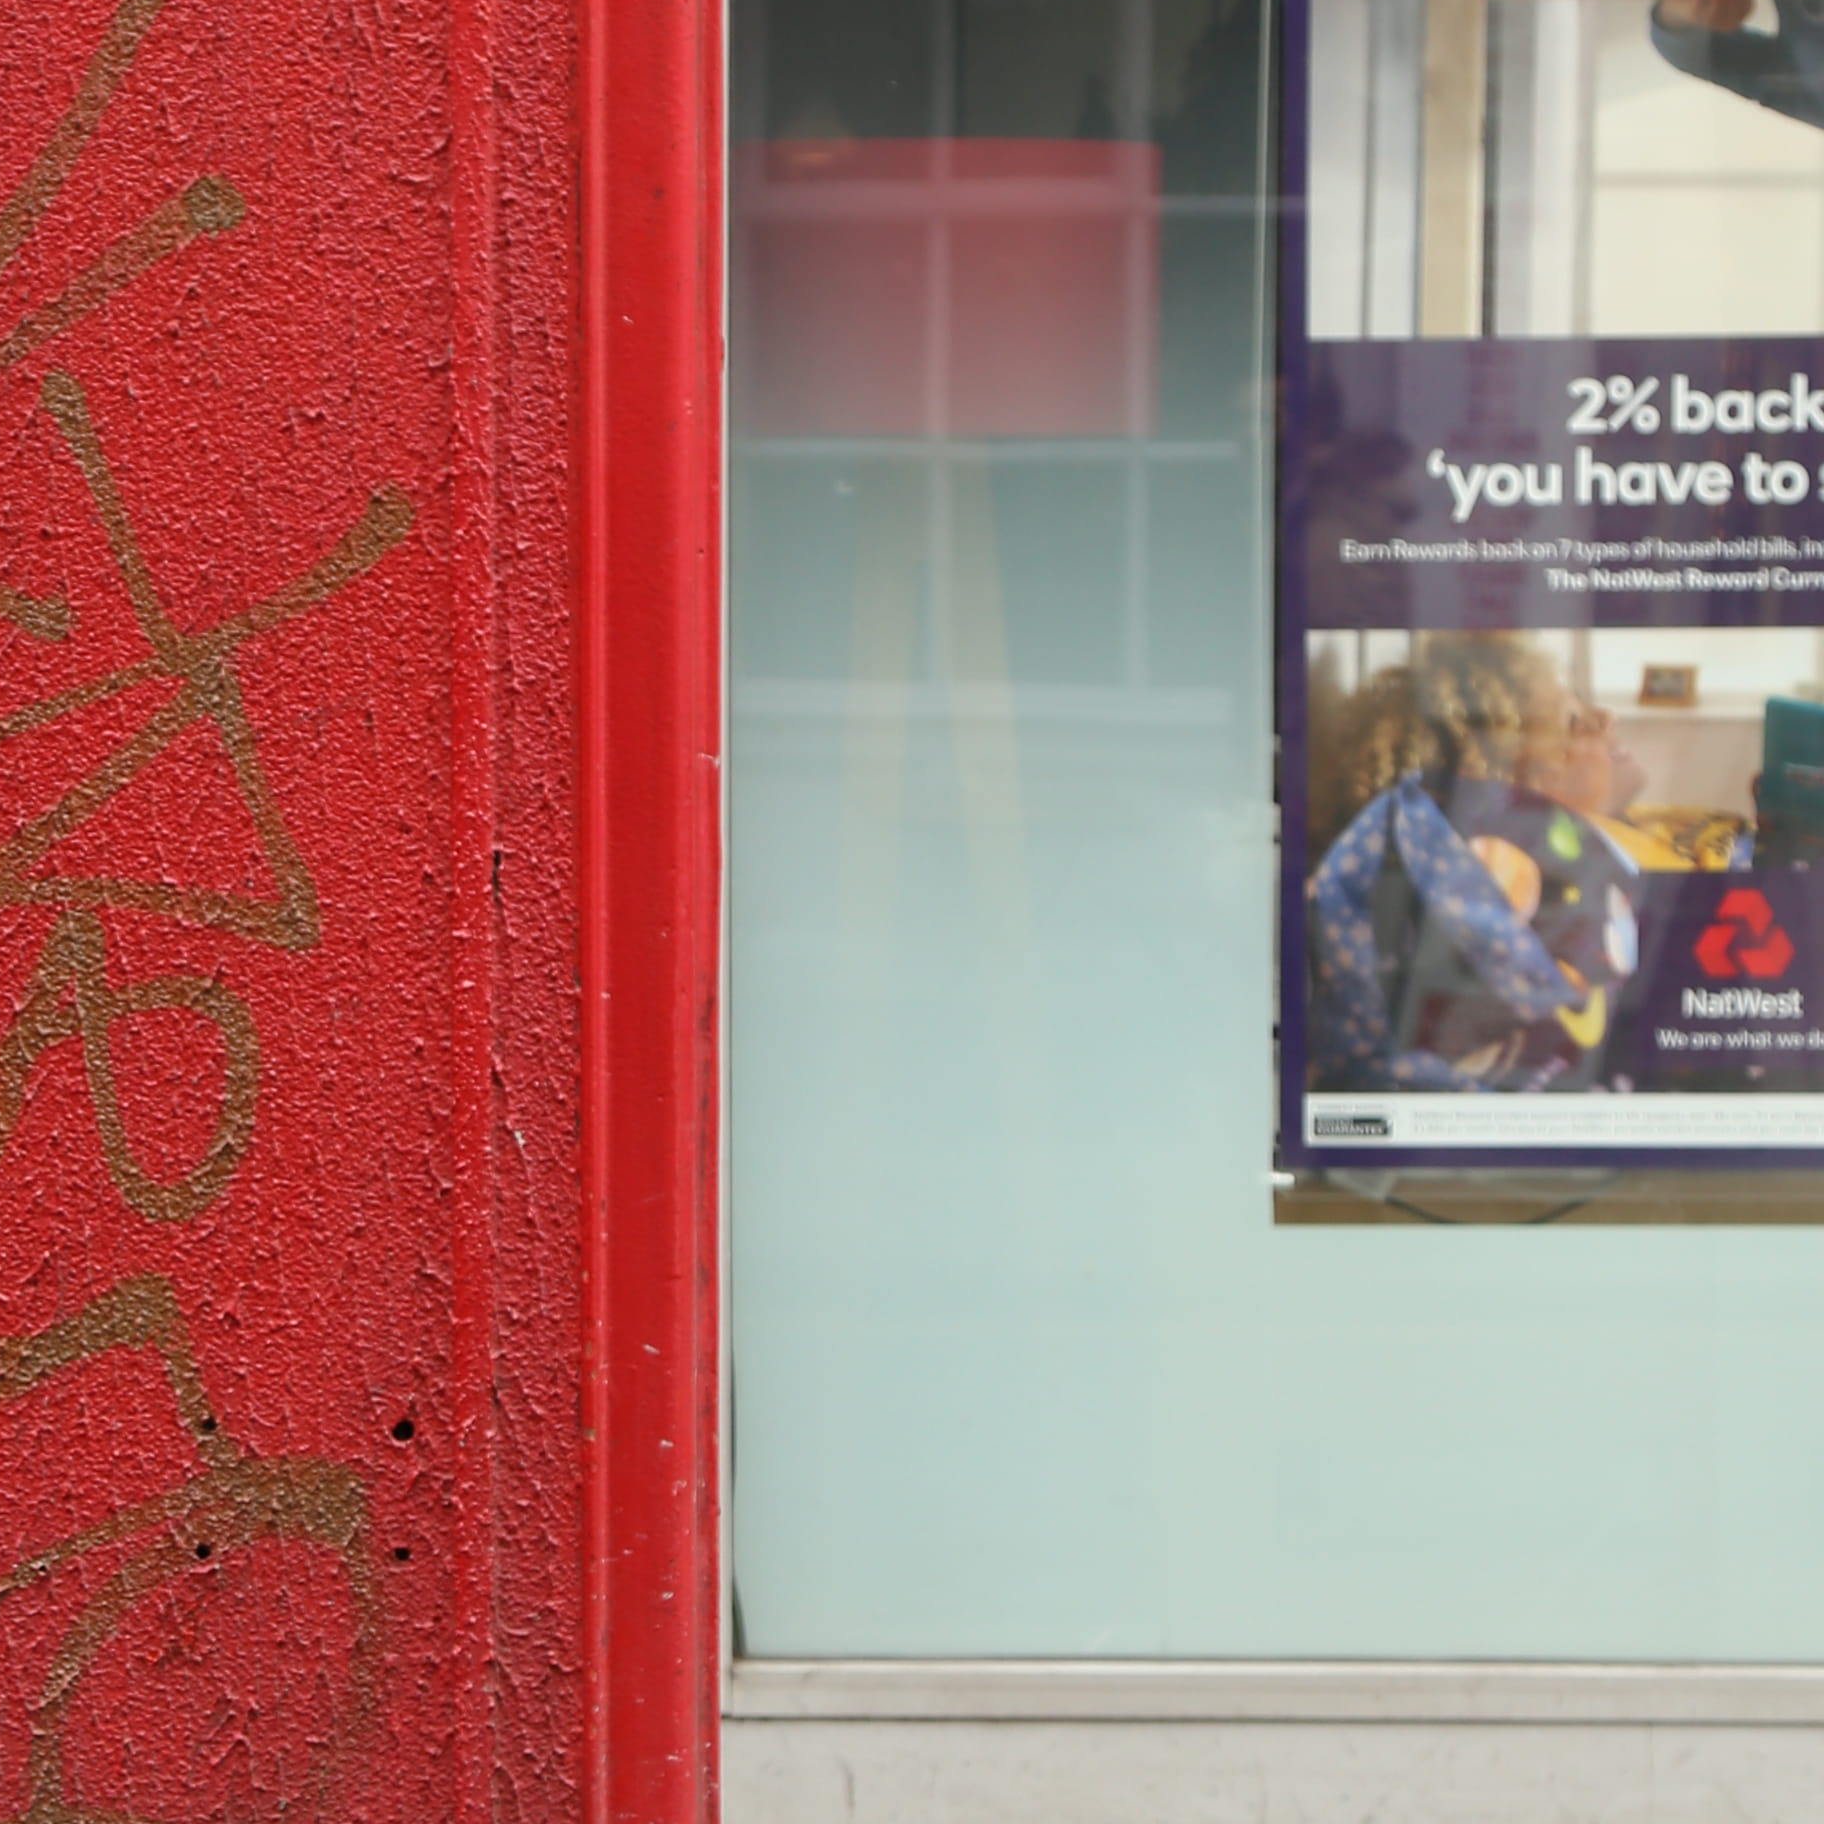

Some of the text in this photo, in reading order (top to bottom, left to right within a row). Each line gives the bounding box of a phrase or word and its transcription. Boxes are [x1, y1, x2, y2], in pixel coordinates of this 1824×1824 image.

[1566, 374, 1661, 435] 2%
[1670, 372, 1824, 435] back
[1574, 445, 1734, 506] have
[1742, 452, 1809, 506] to
[1340, 538, 1390, 563] Earn
[1390, 538, 1478, 563] Rewards
[1477, 537, 1527, 562] back
[1526, 542, 1558, 562] on
[1574, 539, 1630, 565] types
[1629, 536, 1656, 562] of
[1656, 536, 1759, 562] household
[1544, 568, 1589, 592] The
[1588, 567, 1682, 592] NatWest
[1681, 567, 1770, 592] Reward
[1681, 987, 1804, 1019] NatWest
[1654, 1027, 1689, 1051] We
[1690, 1031, 1722, 1051] are
[1726, 1028, 1773, 1051] what
[1776, 1031, 1805, 1051] we
